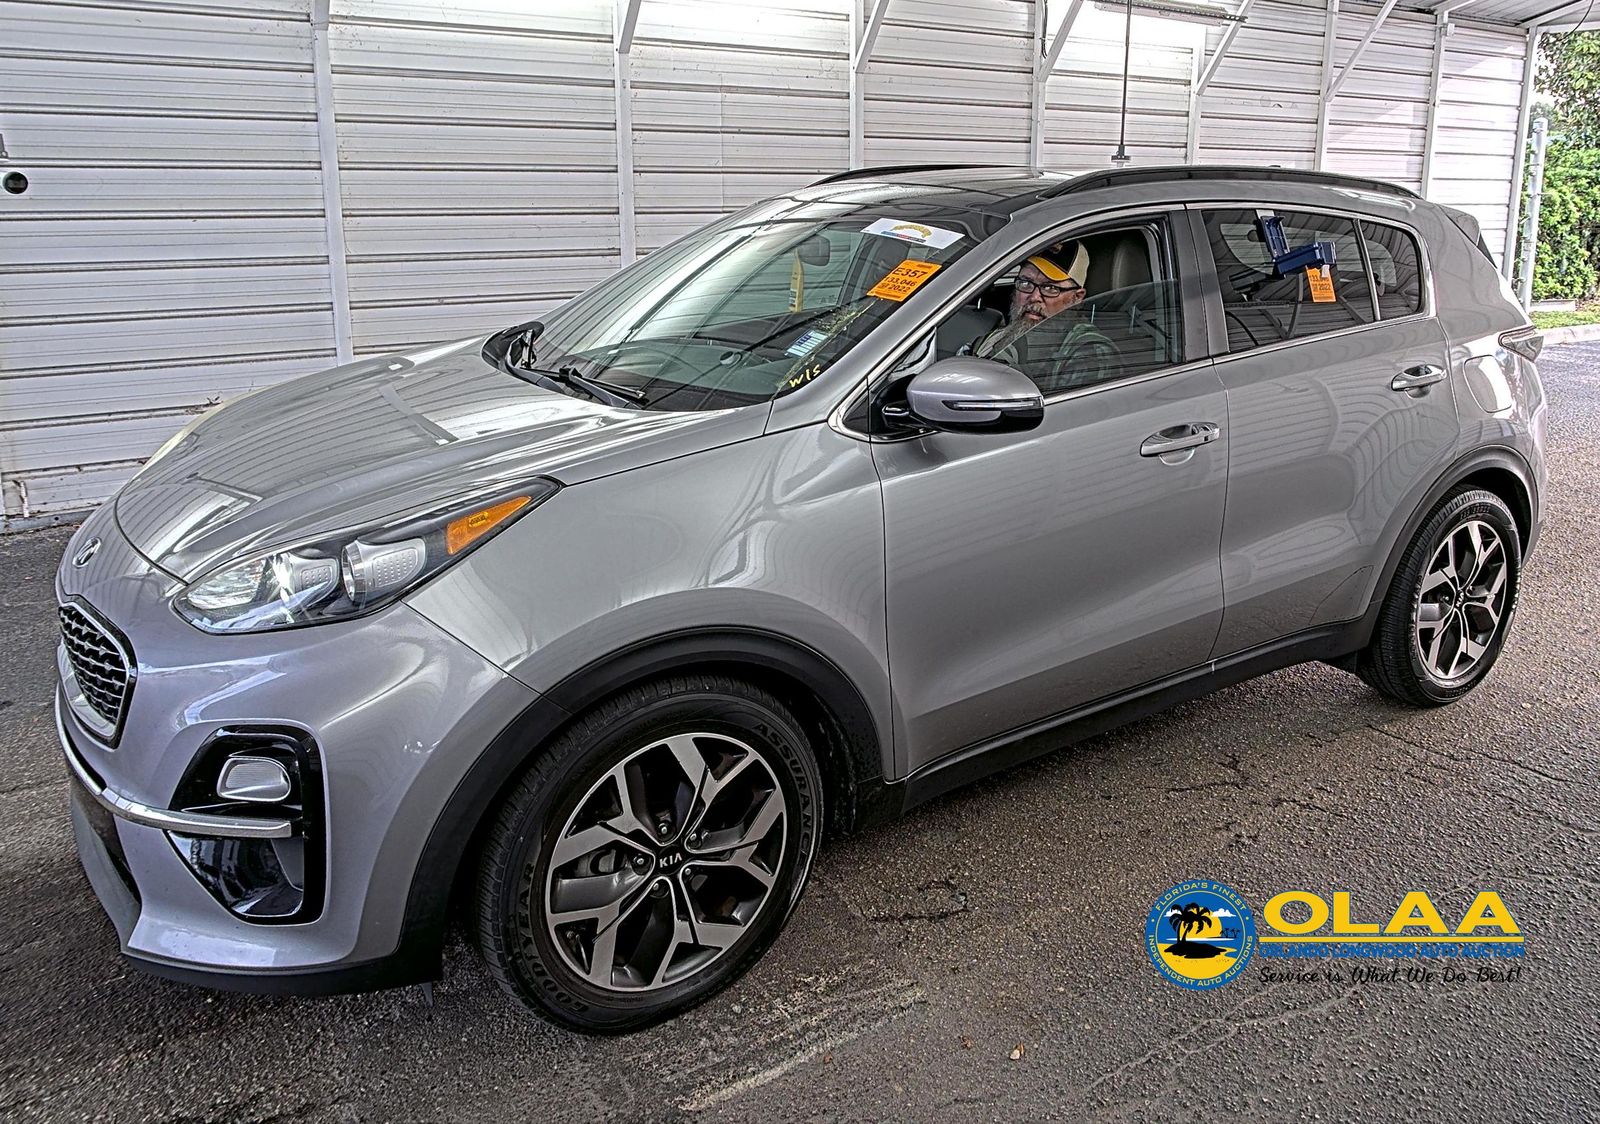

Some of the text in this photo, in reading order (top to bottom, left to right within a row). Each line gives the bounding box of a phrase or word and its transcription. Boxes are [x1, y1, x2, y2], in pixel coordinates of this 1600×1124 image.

[892, 267, 928, 279] E357
[752, 722, 812, 866] ASSURANC
[659, 852, 683, 869] KIA
[518, 862, 590, 1013] GOODYEAR
